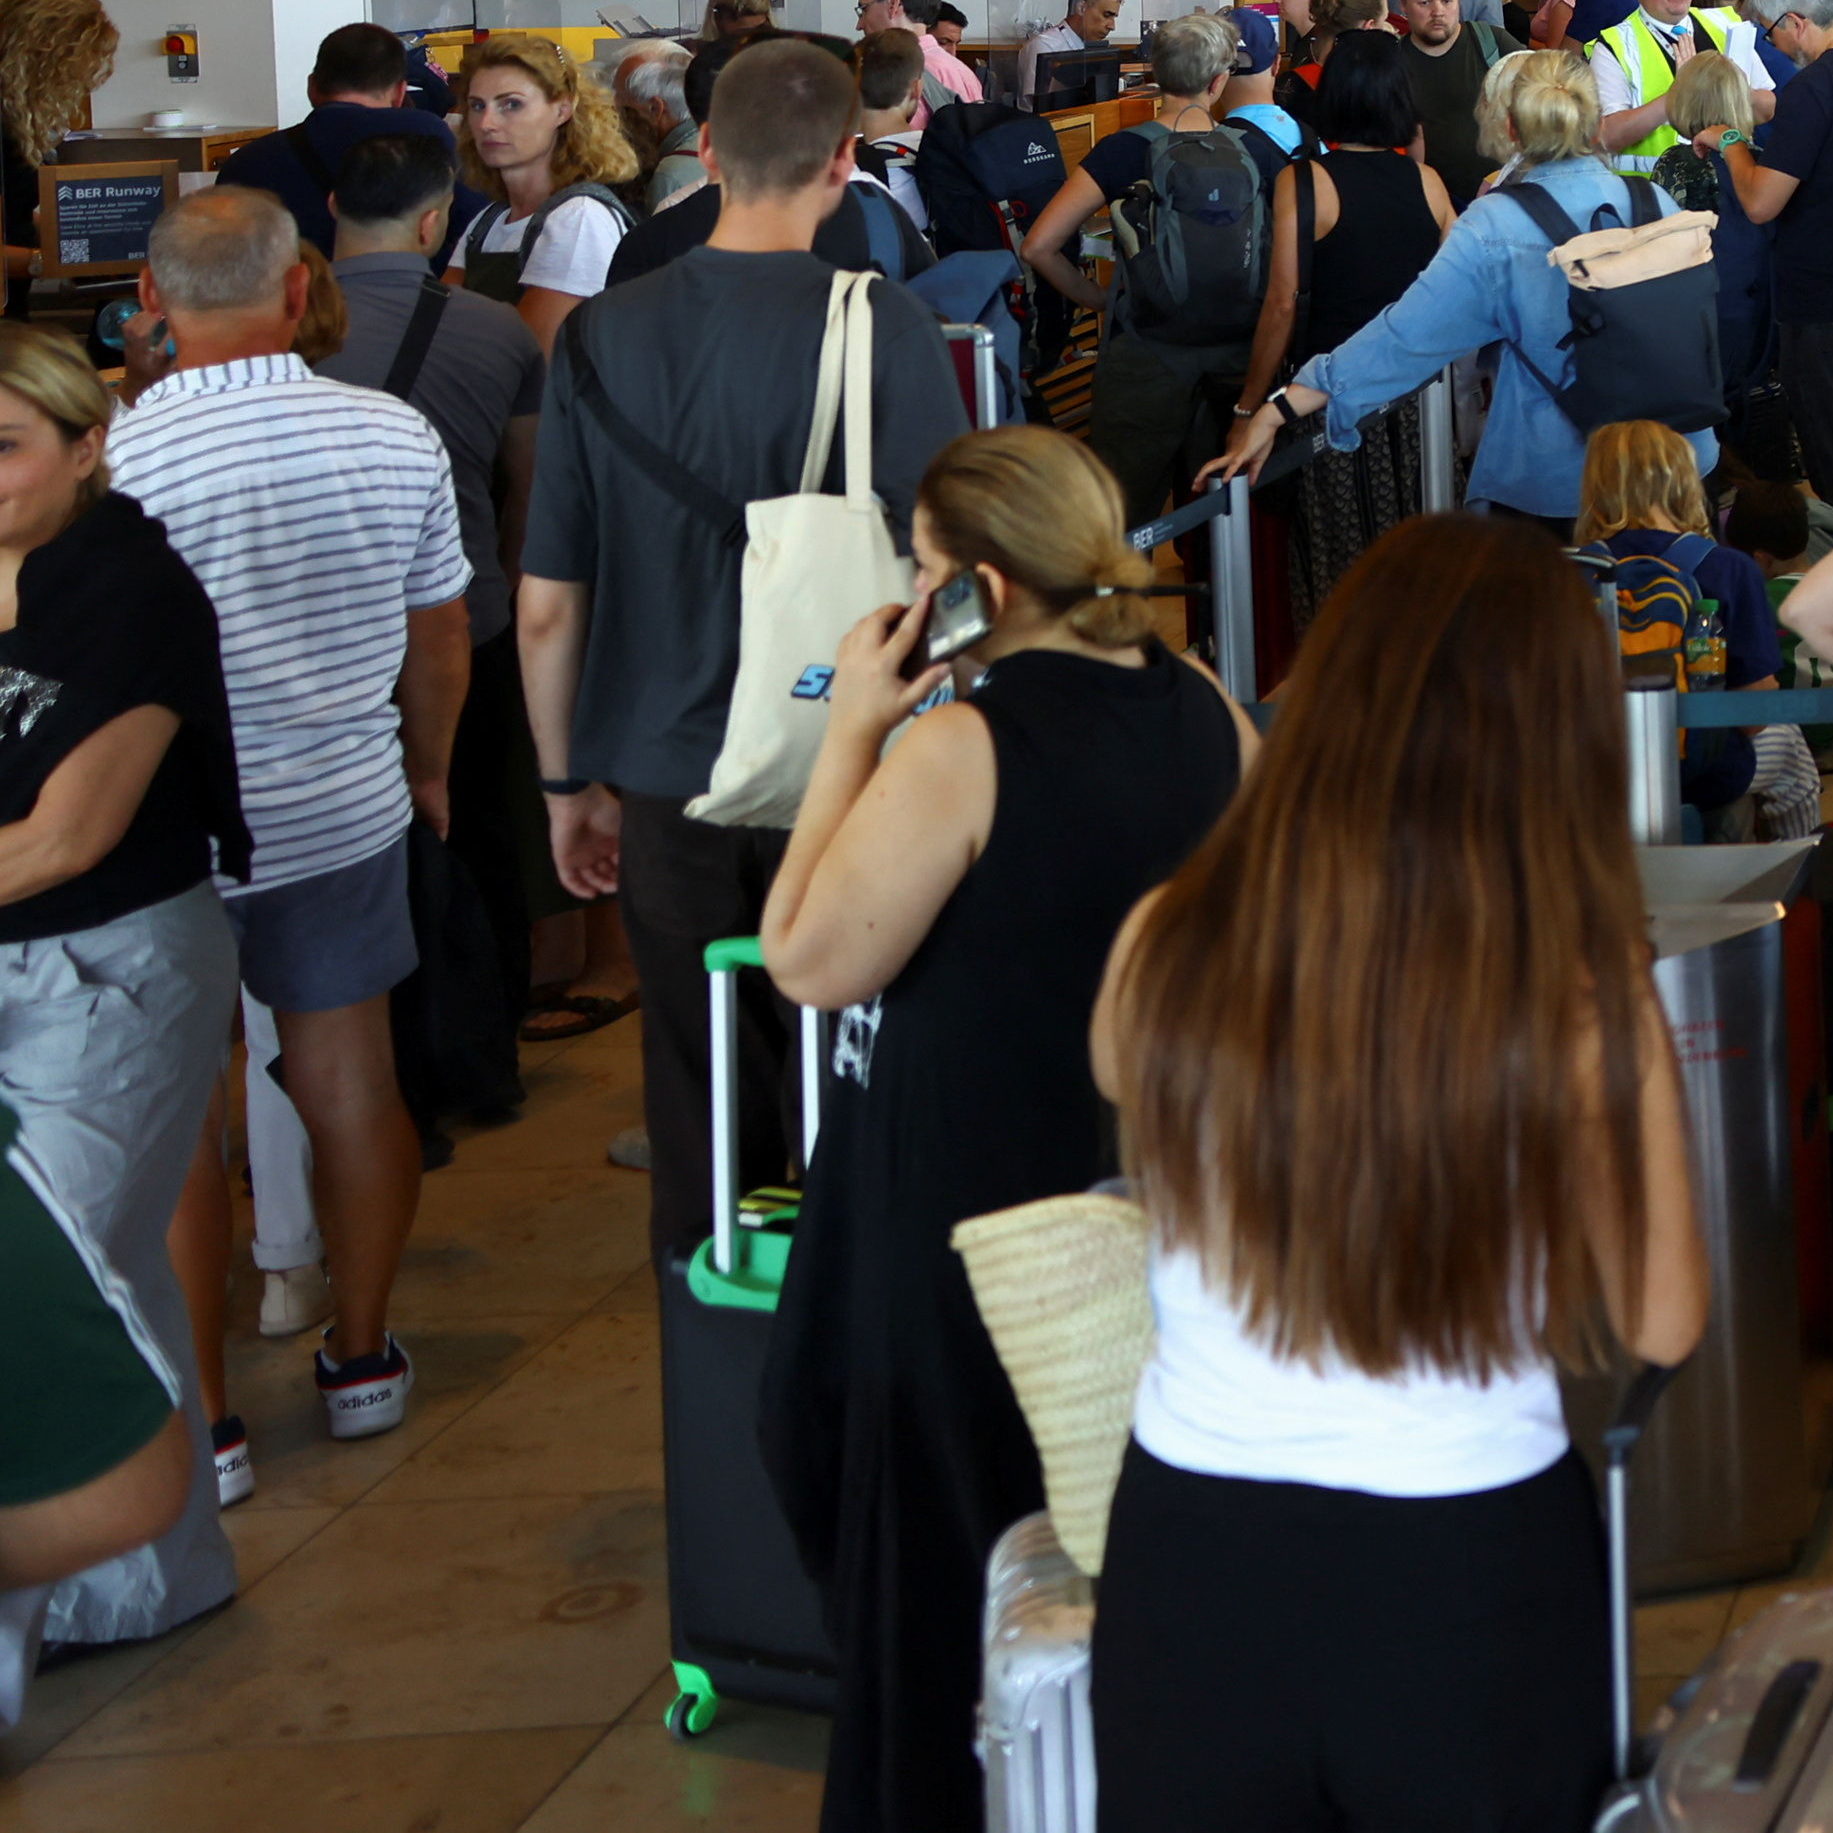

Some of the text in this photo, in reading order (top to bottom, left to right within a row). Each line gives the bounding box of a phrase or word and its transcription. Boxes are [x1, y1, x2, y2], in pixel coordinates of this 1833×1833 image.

[75, 186, 161, 199] BER Runway
[128, 252, 145, 260] BER
[1132, 526, 1154, 553] BER
[337, 1388, 393, 1410] adidas
